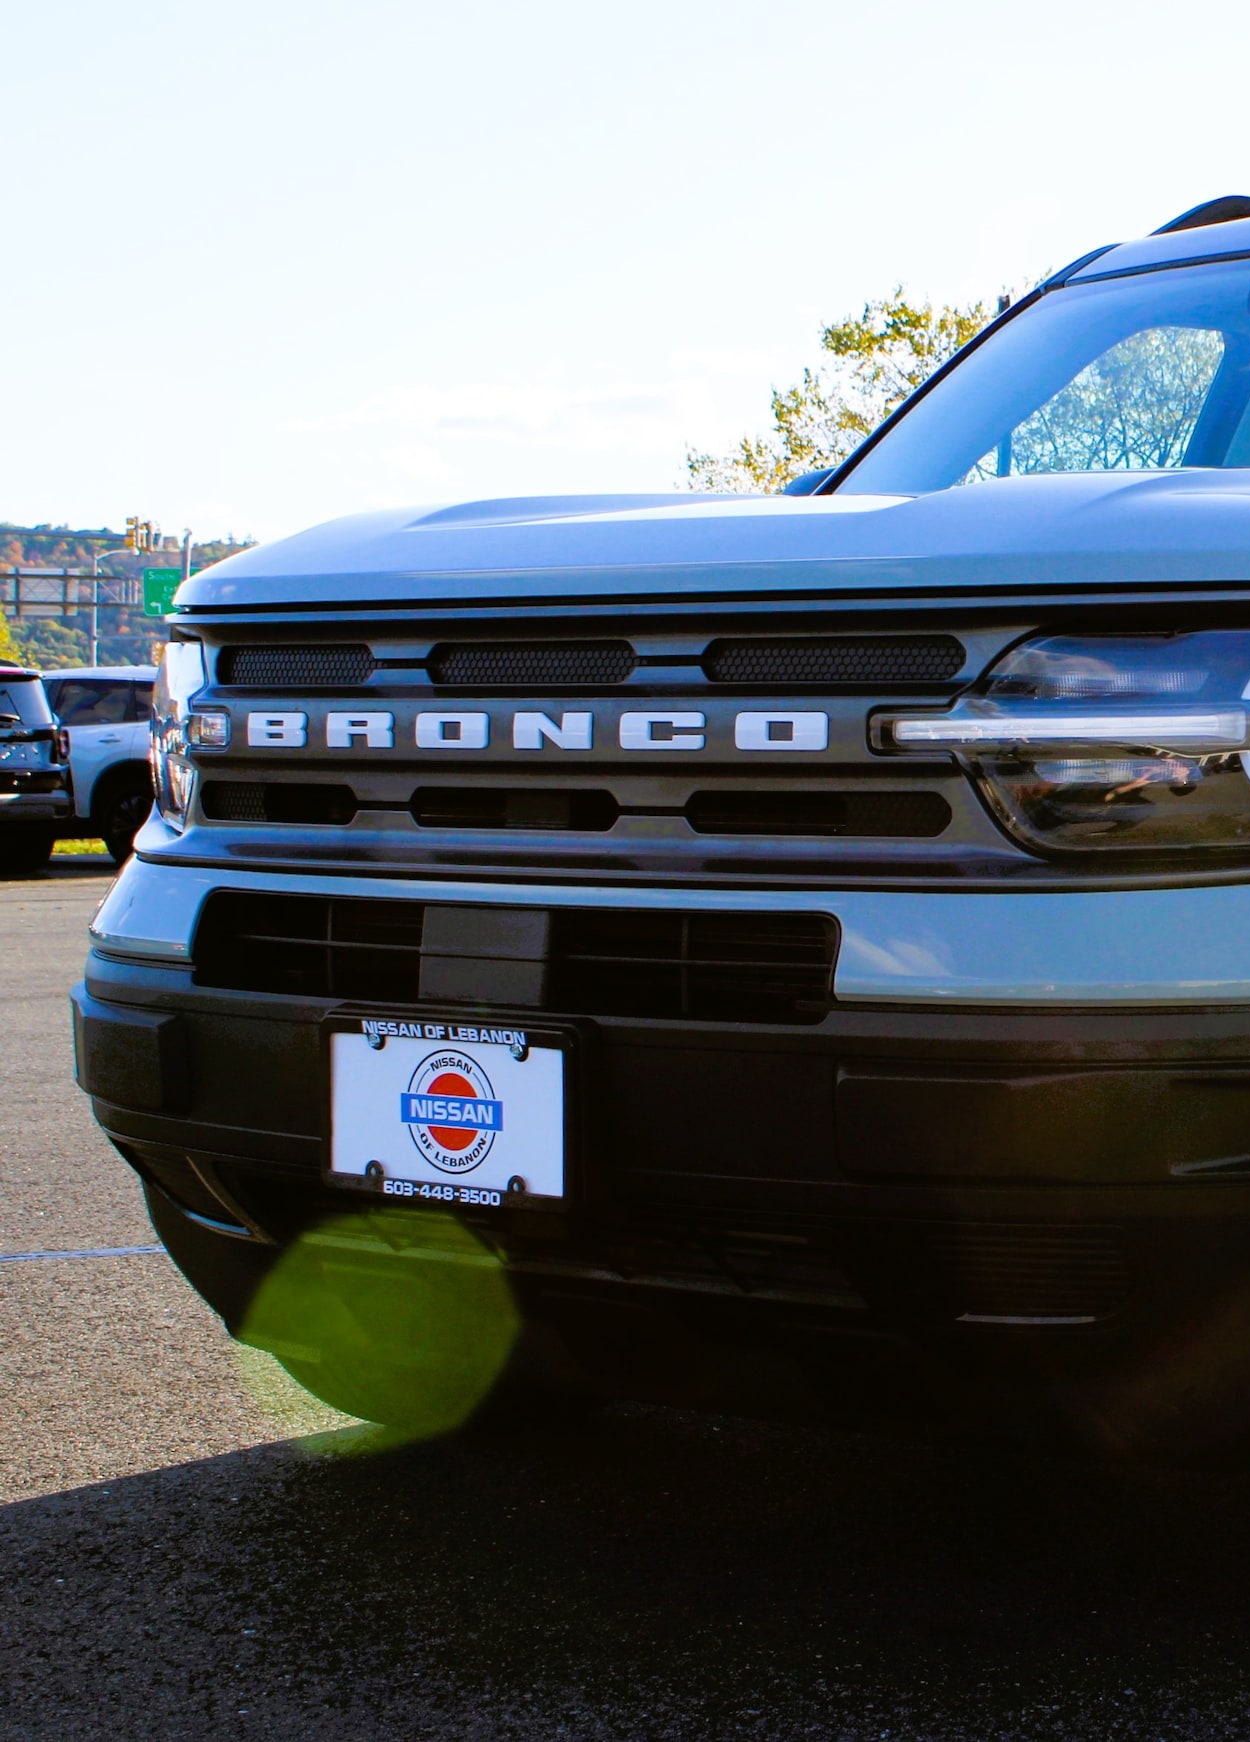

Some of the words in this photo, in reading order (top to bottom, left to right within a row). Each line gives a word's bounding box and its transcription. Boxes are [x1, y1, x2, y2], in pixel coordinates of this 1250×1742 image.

[247, 711, 829, 751] BRONCO
[361, 1020, 423, 1038] NISSAN
[424, 1024, 445, 1040] OF
[449, 1026, 526, 1046] LEBANON
[430, 1057, 473, 1075] NISSAN
[410, 1098, 493, 1124] NISSAN
[419, 1132, 434, 1151] OF
[434, 1137, 487, 1167] LEBANON
[383, 1180, 501, 1206] 603-448-3500
